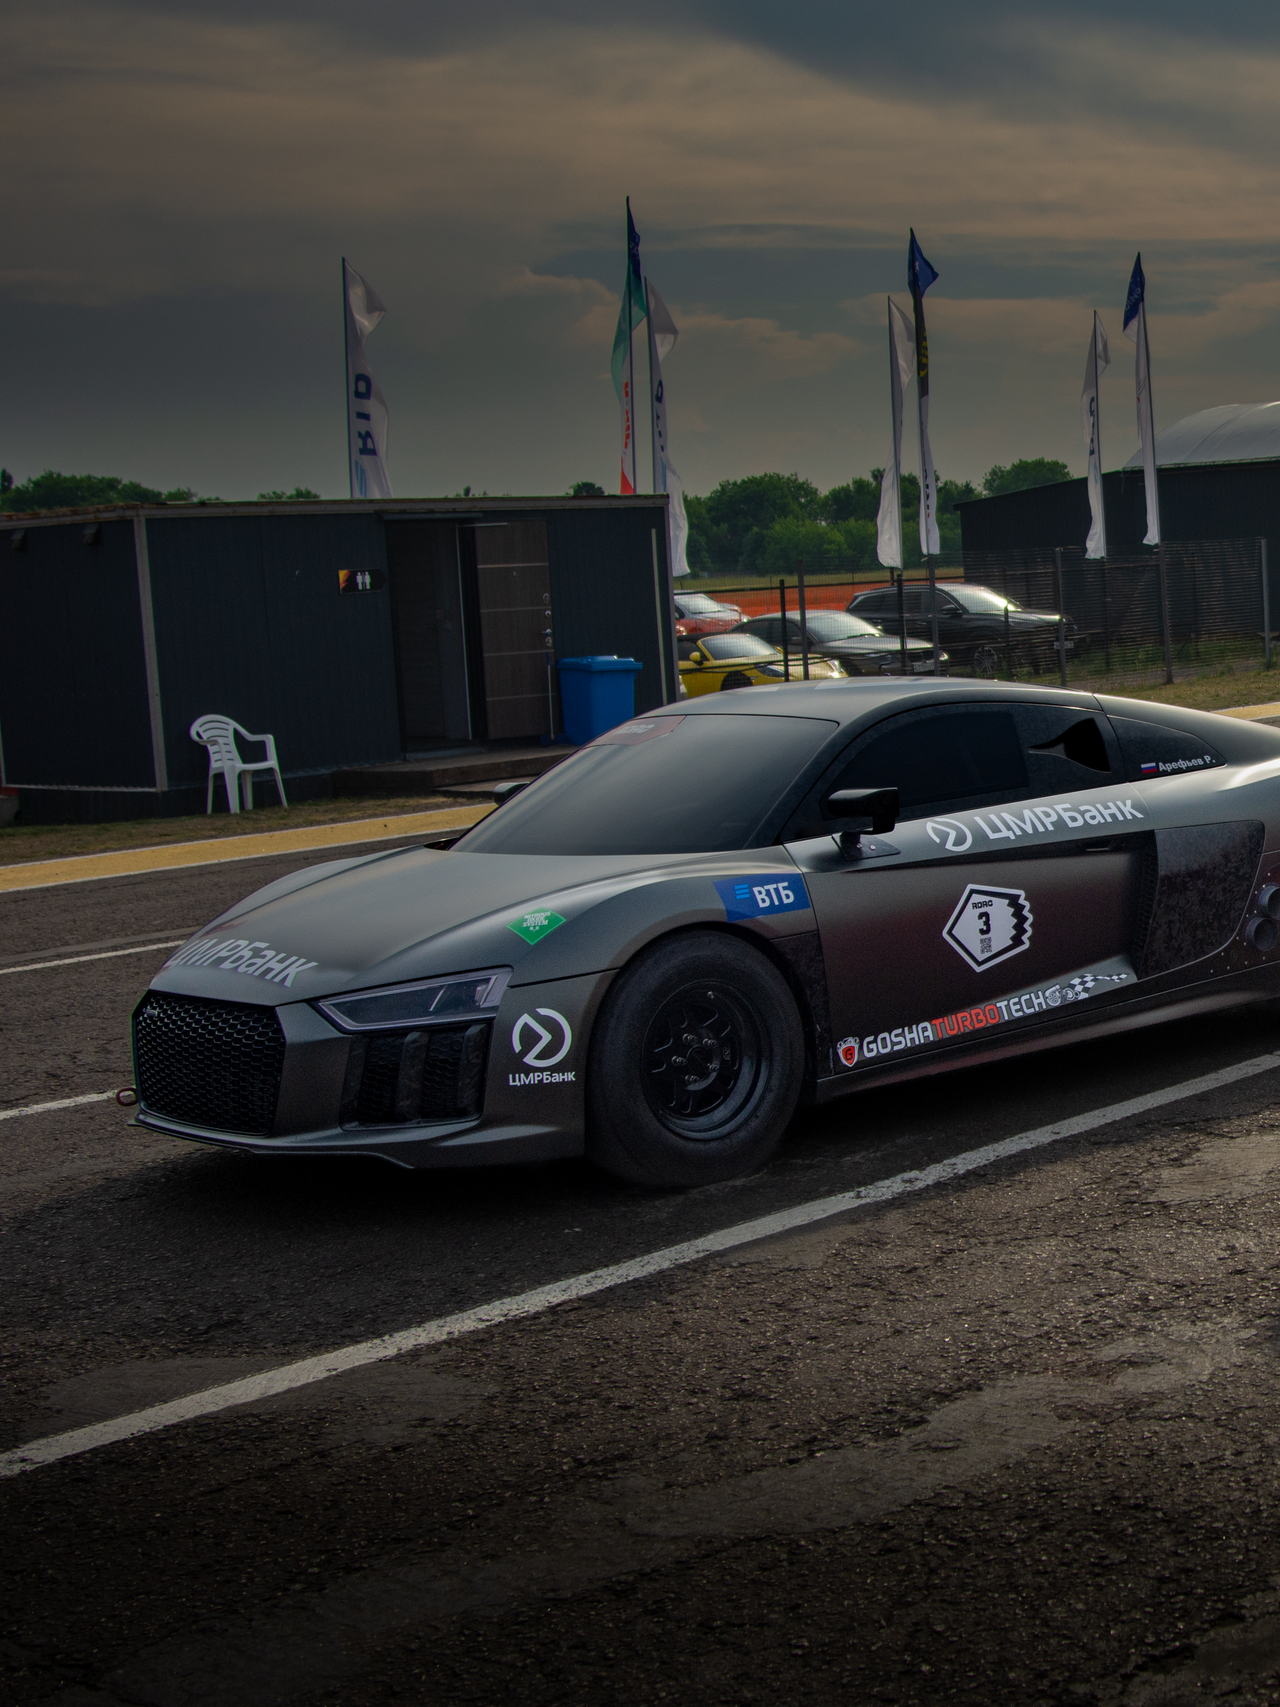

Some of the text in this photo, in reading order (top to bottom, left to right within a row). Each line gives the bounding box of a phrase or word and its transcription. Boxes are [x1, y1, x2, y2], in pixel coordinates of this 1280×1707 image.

[1158, 759, 1204, 772] Арефьев
[973, 799, 1144, 840] ЦМРБанк
[752, 882, 795, 908] ВТБ
[971, 900, 993, 910] RDRC
[977, 911, 991, 935] 3
[862, 991, 1047, 1058] GOSHATURBOTECH
[508, 1071, 576, 1087] ЦМРБанк
